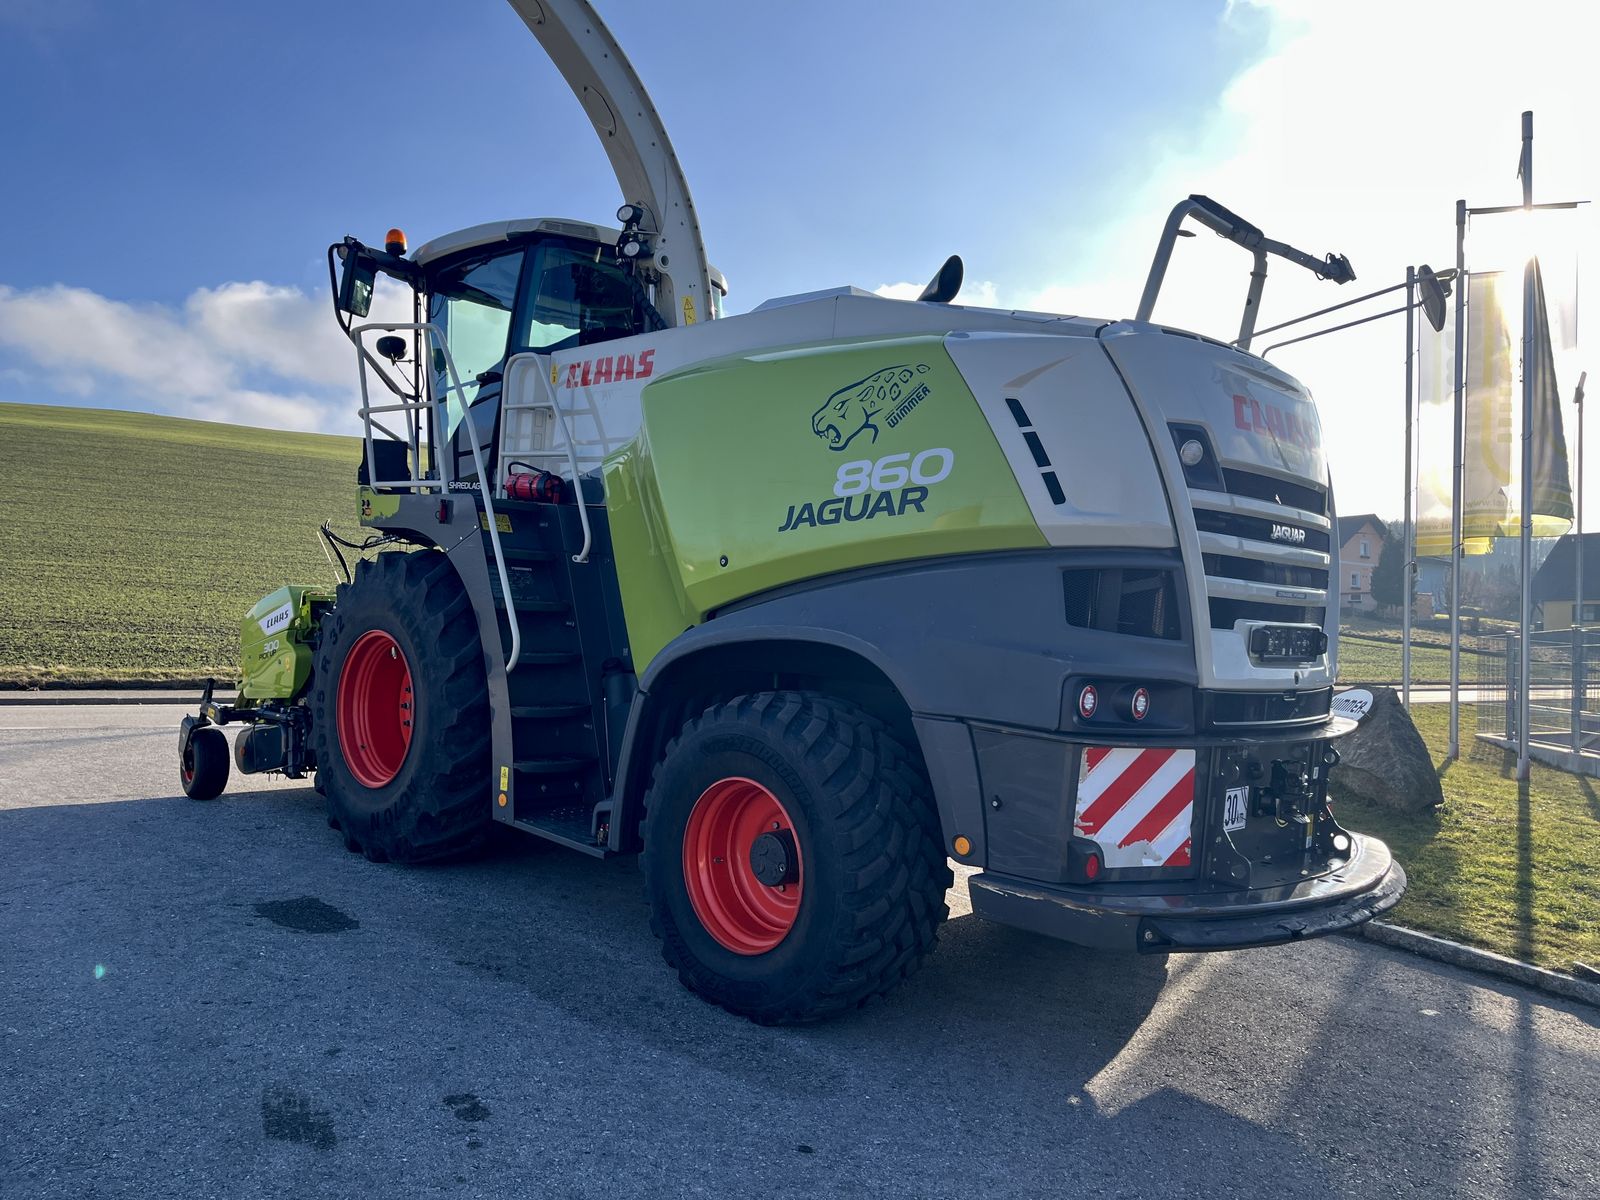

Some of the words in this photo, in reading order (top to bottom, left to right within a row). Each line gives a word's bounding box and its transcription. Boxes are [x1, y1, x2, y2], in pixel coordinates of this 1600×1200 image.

[566, 349, 655, 388] CLAAS
[887, 386, 931, 428] WIMMER
[1232, 394, 1317, 450] CLAAS
[449, 482, 481, 490] SHREDLAG
[833, 448, 954, 497] 860
[778, 486, 929, 532] JAGUAR
[1270, 524, 1306, 542] JAGUAR
[266, 610, 289, 628] CLAAS
[263, 640, 279, 653] 300
[1225, 794, 1238, 826] 30
